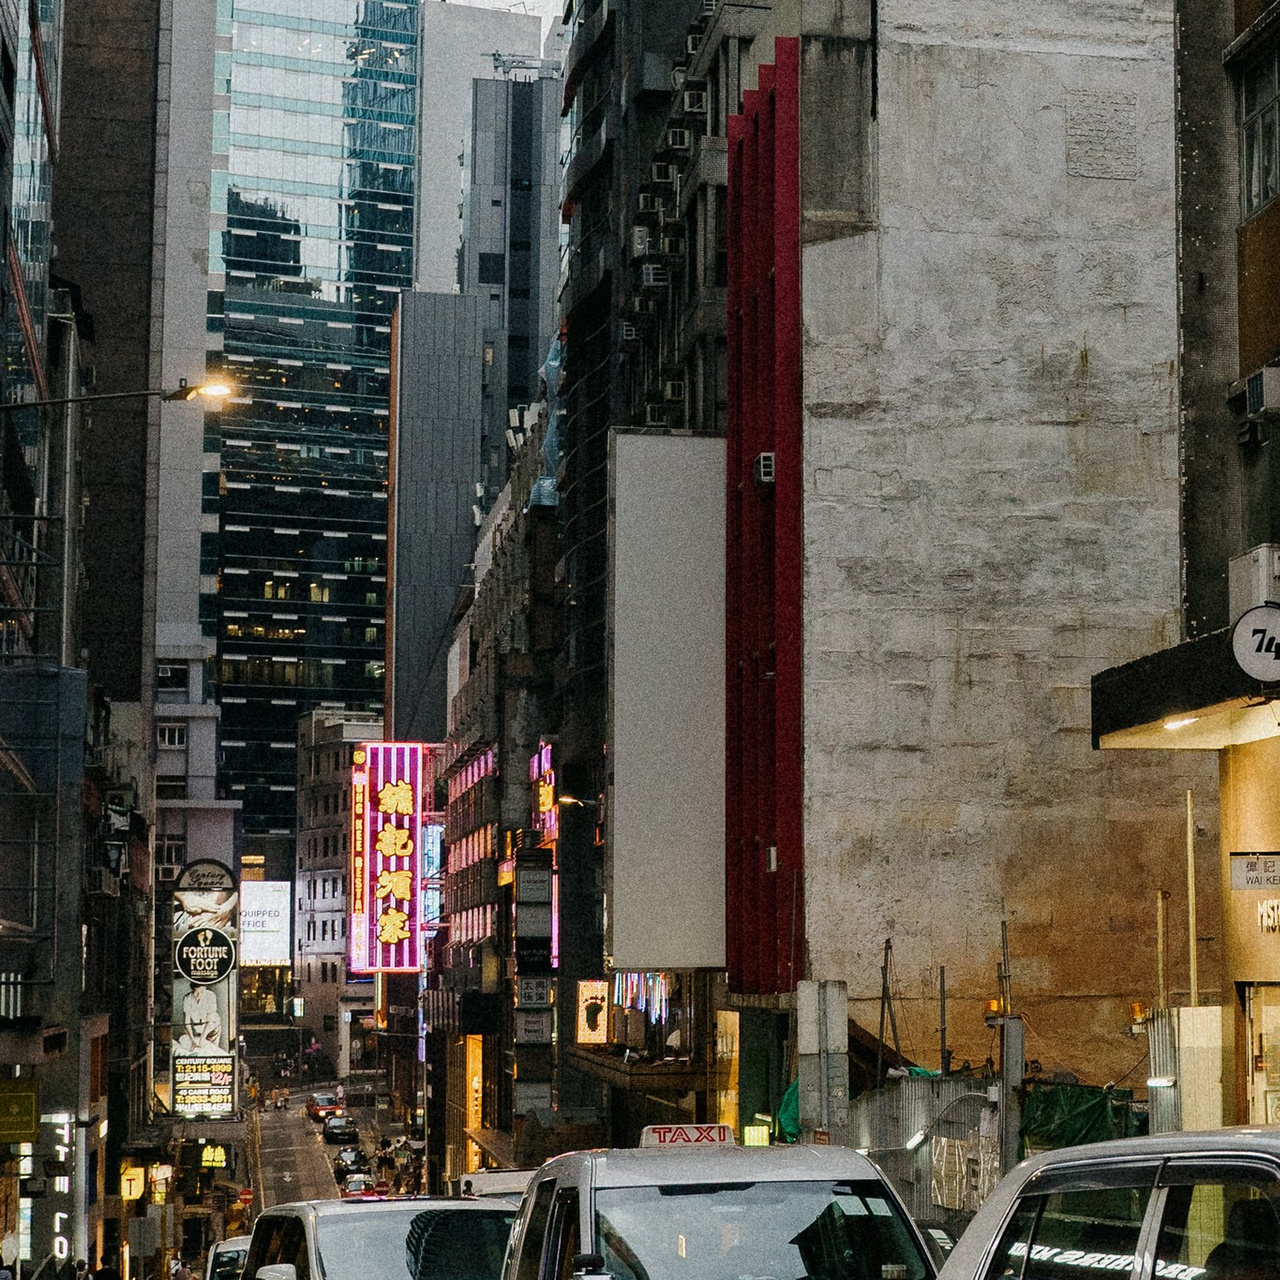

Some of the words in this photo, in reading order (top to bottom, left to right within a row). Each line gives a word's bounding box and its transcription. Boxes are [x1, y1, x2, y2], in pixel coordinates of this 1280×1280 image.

[1246, 875, 1263, 885] WAI
[241, 909, 280, 918] QUIPPED
[183, 946, 228, 959] FORTUNE
[190, 958, 219, 970] FOOT
[652, 1125, 726, 1143] TAXI
